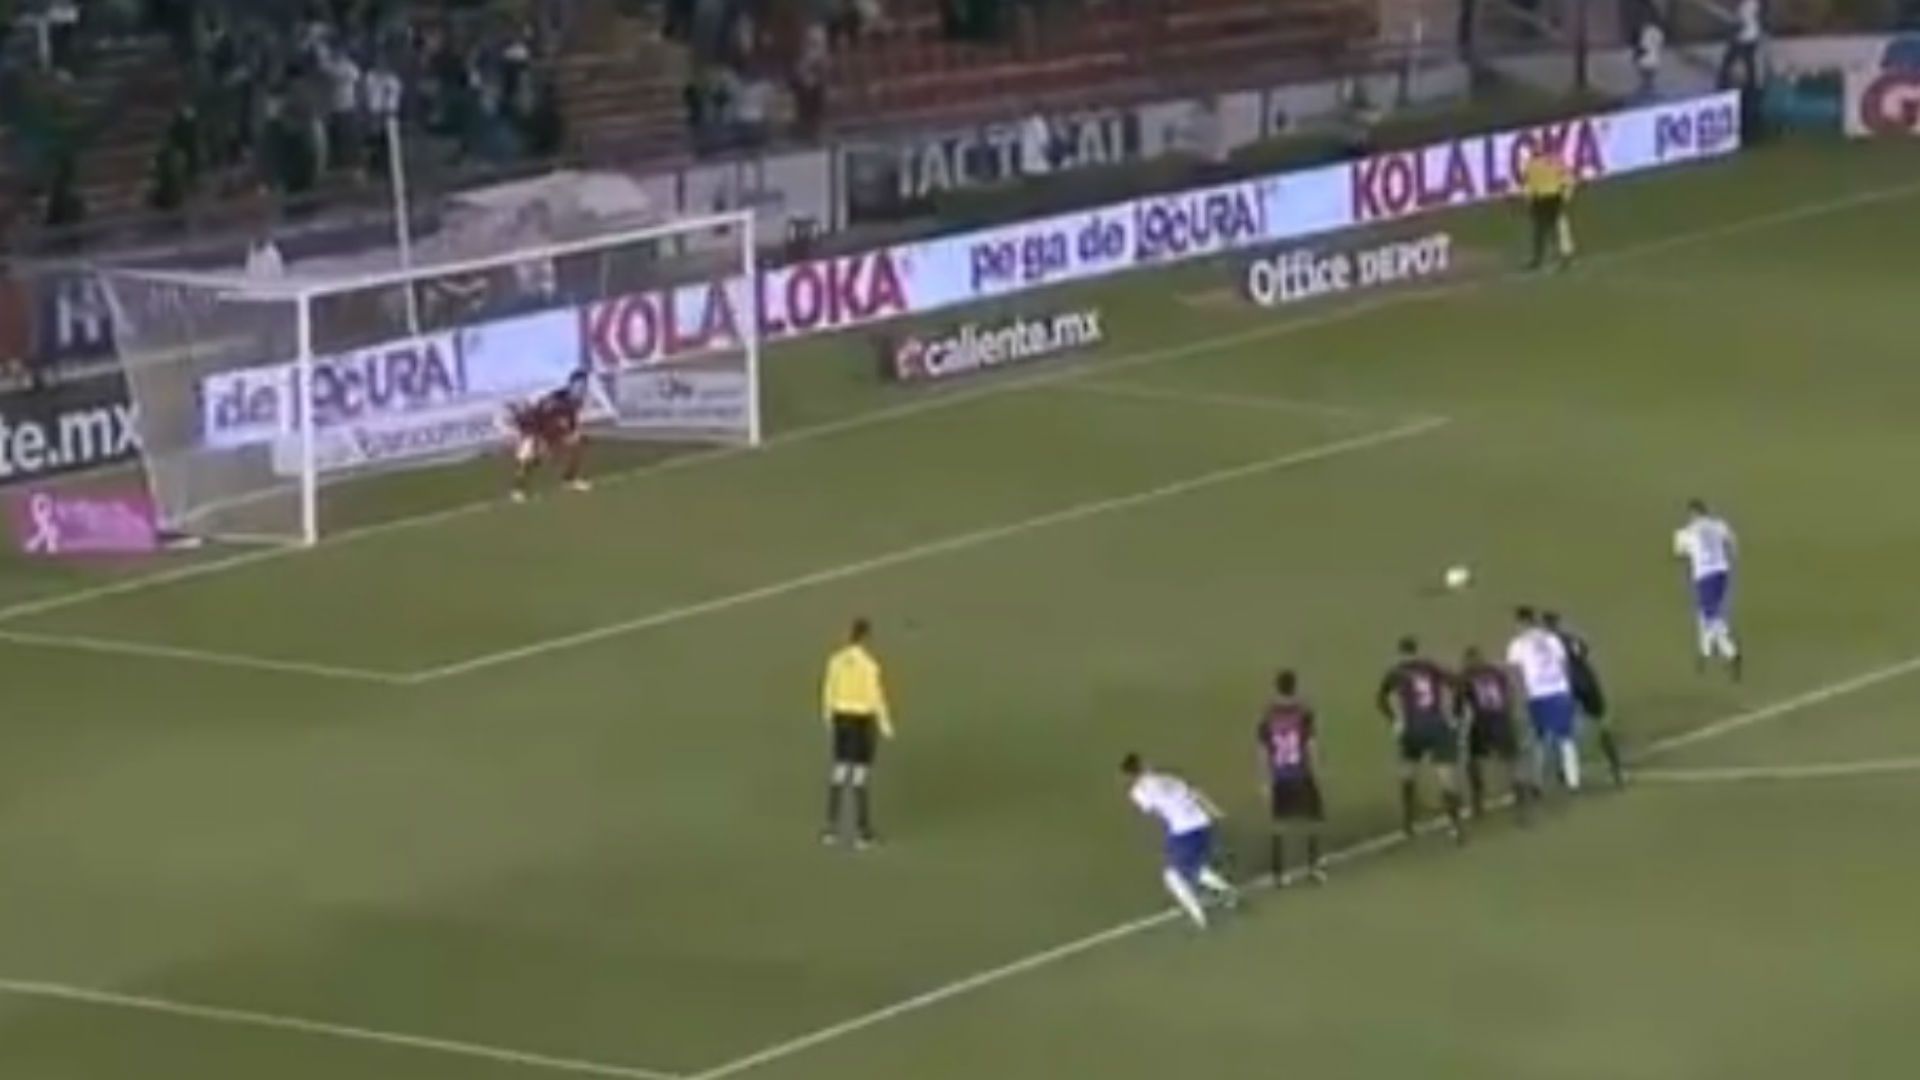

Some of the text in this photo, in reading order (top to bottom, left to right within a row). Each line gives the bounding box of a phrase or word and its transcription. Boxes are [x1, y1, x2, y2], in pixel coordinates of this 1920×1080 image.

[1655, 104, 1732, 157] pega
[1352, 138, 1476, 224] KOLA
[970, 234, 1067, 291] pega
[1078, 217, 1124, 262] de
[1250, 233, 1450, 305] Office DEPOT
[580, 246, 907, 370] KOLA LOKA
[926, 309, 1102, 375] caliente.mx
